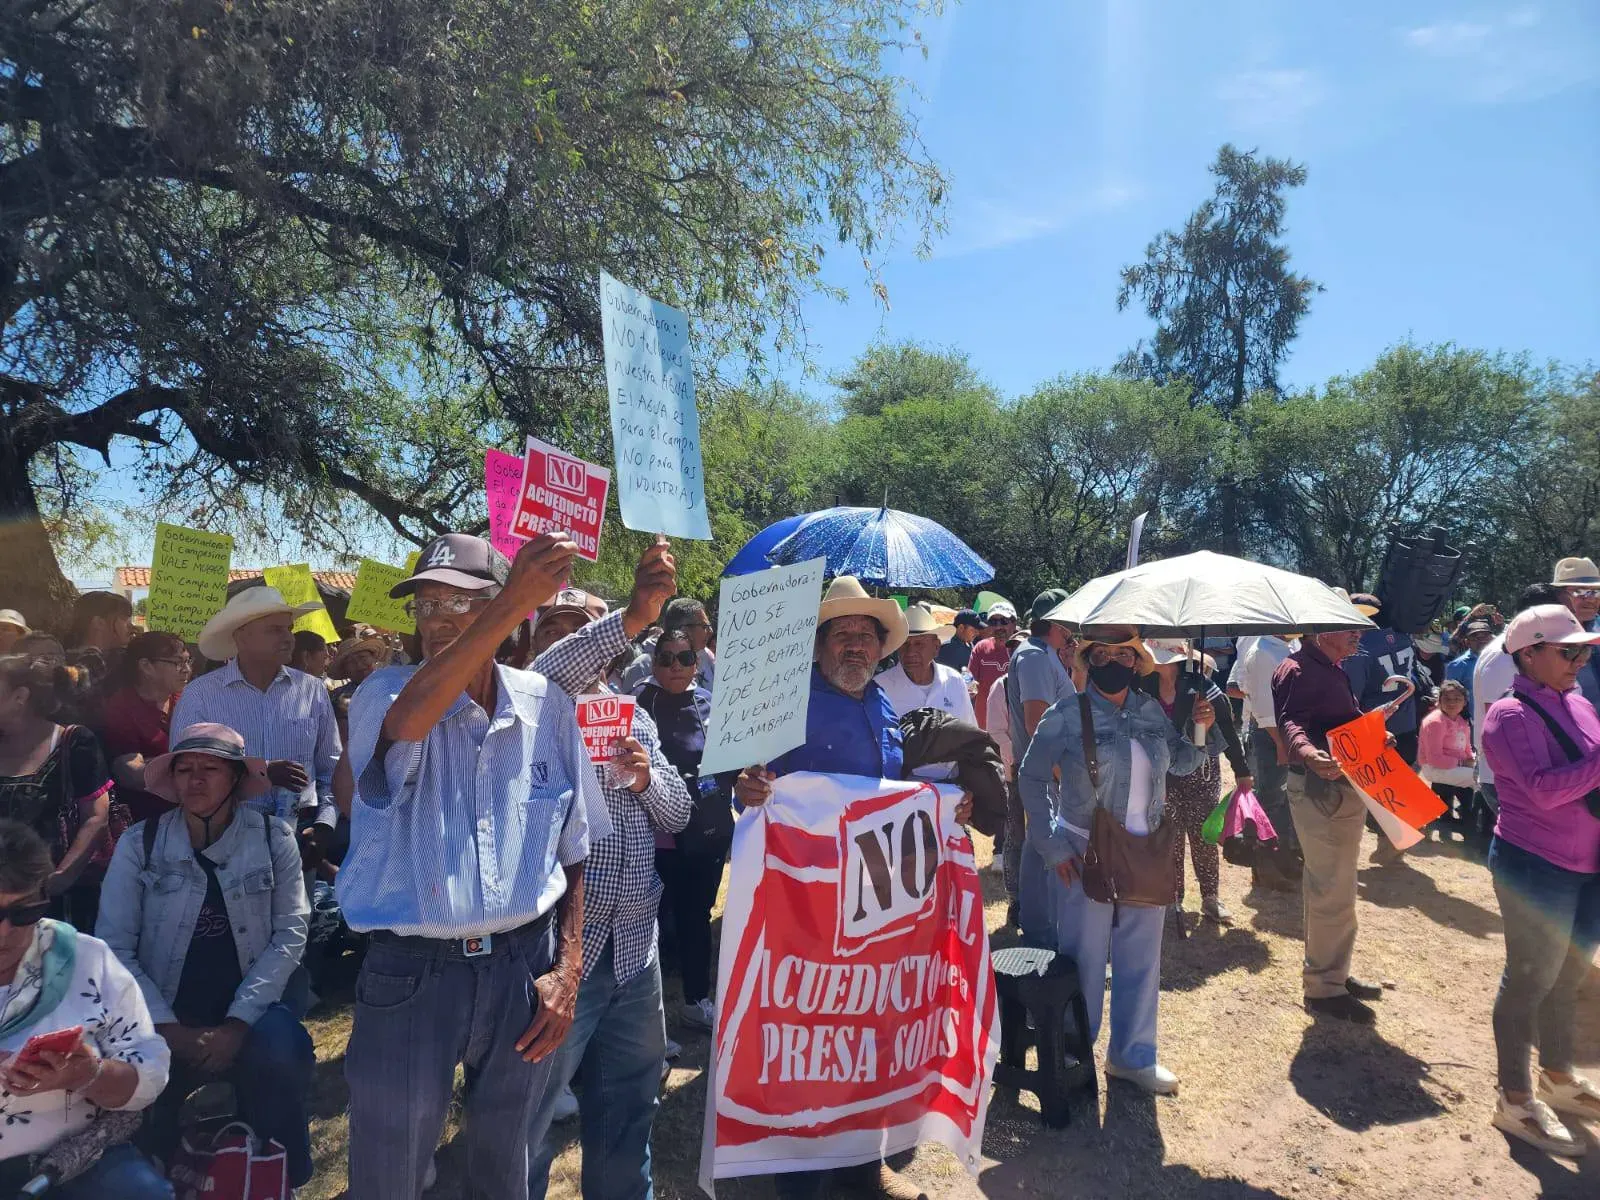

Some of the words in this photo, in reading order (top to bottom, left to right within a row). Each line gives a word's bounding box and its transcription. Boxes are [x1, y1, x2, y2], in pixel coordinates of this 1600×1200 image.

[606, 282, 678, 336] Gobernadora:
[612, 317, 635, 348] NO
[614, 358, 657, 385] nuestra
[617, 387, 633, 407] El
[638, 394, 668, 420] AGUA
[673, 410, 684, 425] es
[620, 418, 644, 440] para
[649, 423, 660, 440] el
[662, 432, 694, 454] campo
[550, 459, 582, 488] NO
[623, 447, 643, 466] NO
[649, 454, 673, 471] para
[680, 457, 697, 479] las
[526, 484, 597, 525] ACUEDUCTO
[587, 497, 597, 508] AL
[628, 473, 694, 510] INDUSTRIAS
[517, 511, 562, 535] PRESA
[552, 511, 561, 523] DE
[562, 515, 572, 527] LA
[161, 541, 173, 552] El
[178, 546, 227, 561] campesino
[161, 555, 188, 569] VALE
[427, 540, 456, 567] LA
[155, 584, 173, 599] hay
[156, 570, 174, 582] Sin
[178, 577, 208, 591] campo
[731, 571, 816, 603] Gobernadora:
[150, 610, 169, 625] hay
[151, 599, 168, 611] Sin
[173, 604, 202, 617] campo
[720, 610, 757, 638] ¡NO
[765, 601, 788, 623] SE
[724, 624, 791, 659] ESCONDA
[791, 615, 817, 635] COMO
[722, 658, 757, 682] LAS
[759, 673, 780, 692] LA
[783, 661, 810, 684] CARA
[590, 700, 616, 719] NO
[720, 710, 734, 732] Y
[742, 692, 785, 721] VENGA
[789, 685, 799, 697] A
[581, 725, 628, 738] CUEDUCTO
[852, 810, 938, 922] NO
[948, 881, 976, 946] AL
[757, 1022, 877, 1084] PRESA
[889, 1007, 960, 1078] SOLIS
